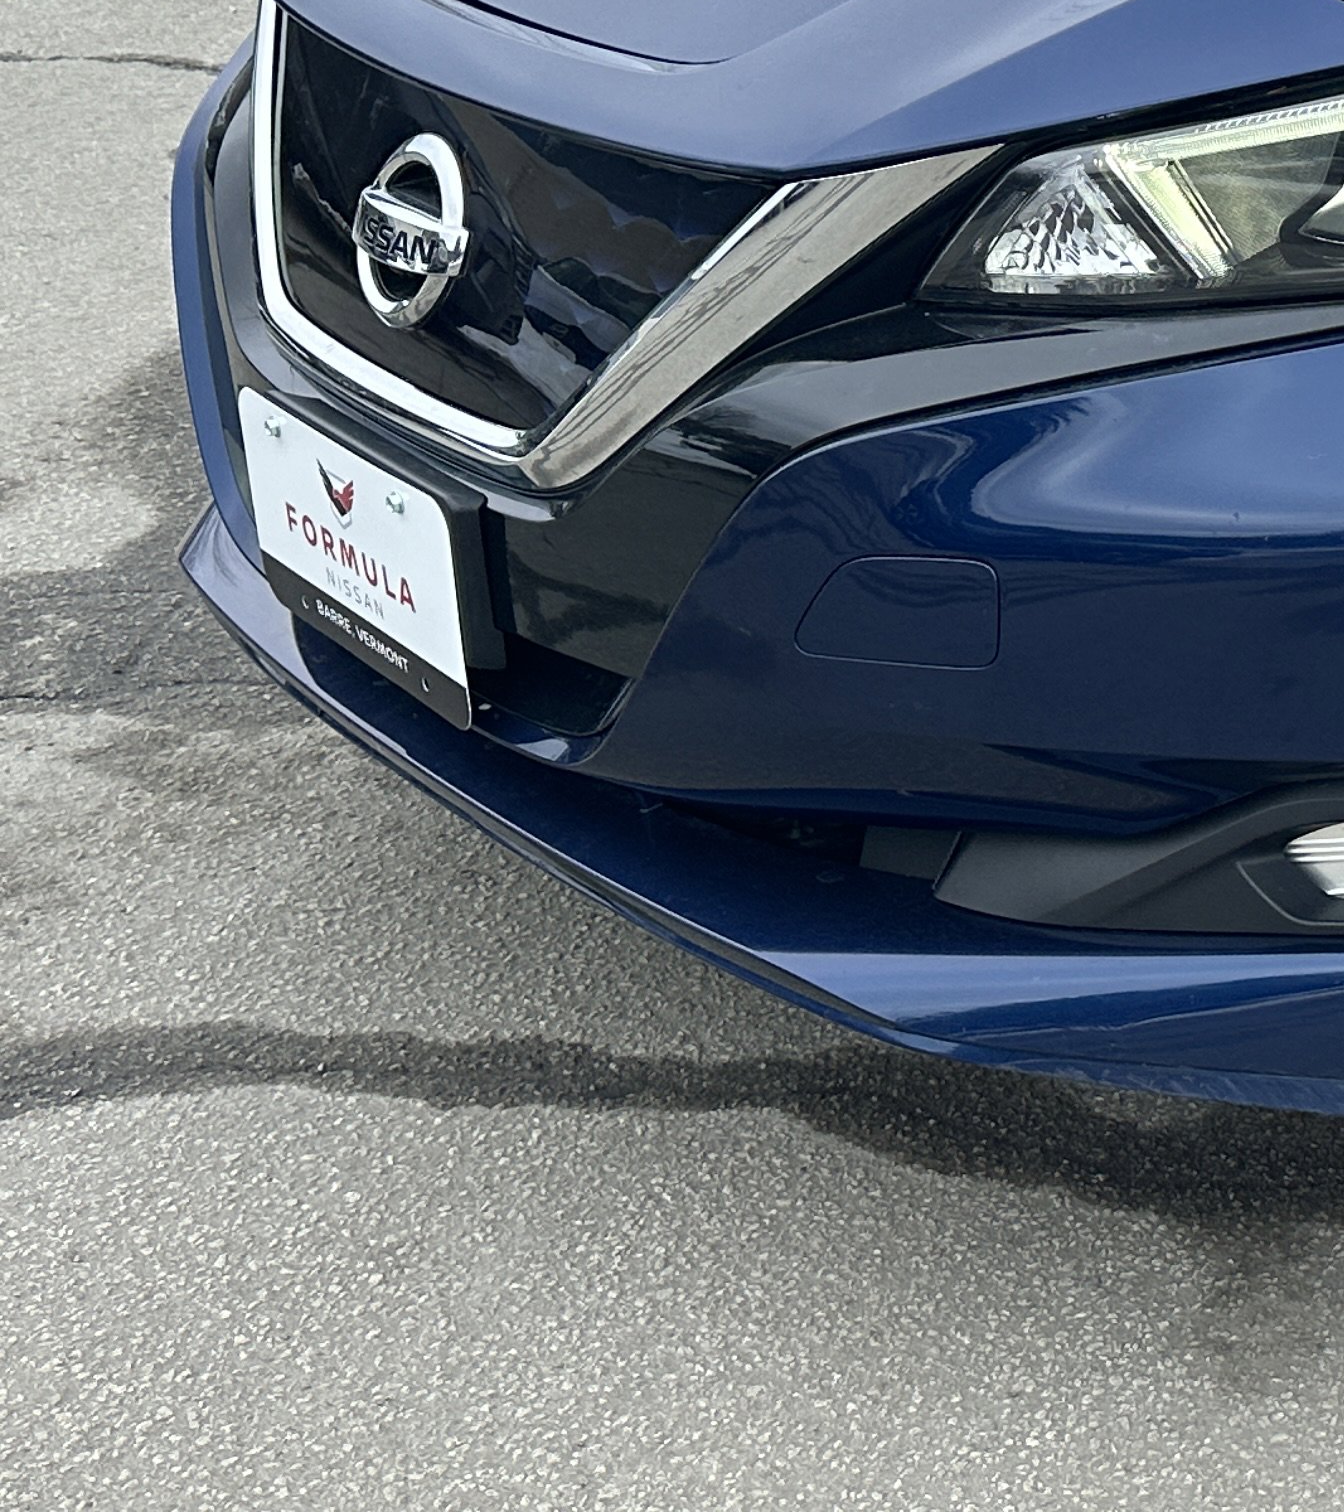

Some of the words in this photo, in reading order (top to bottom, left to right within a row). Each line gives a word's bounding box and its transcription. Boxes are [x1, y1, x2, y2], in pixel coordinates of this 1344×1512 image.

[363, 216, 438, 264] SSAN
[285, 501, 416, 613] FORMULA
[326, 567, 385, 619] NISSAN
[355, 625, 409, 673] VERMONT
